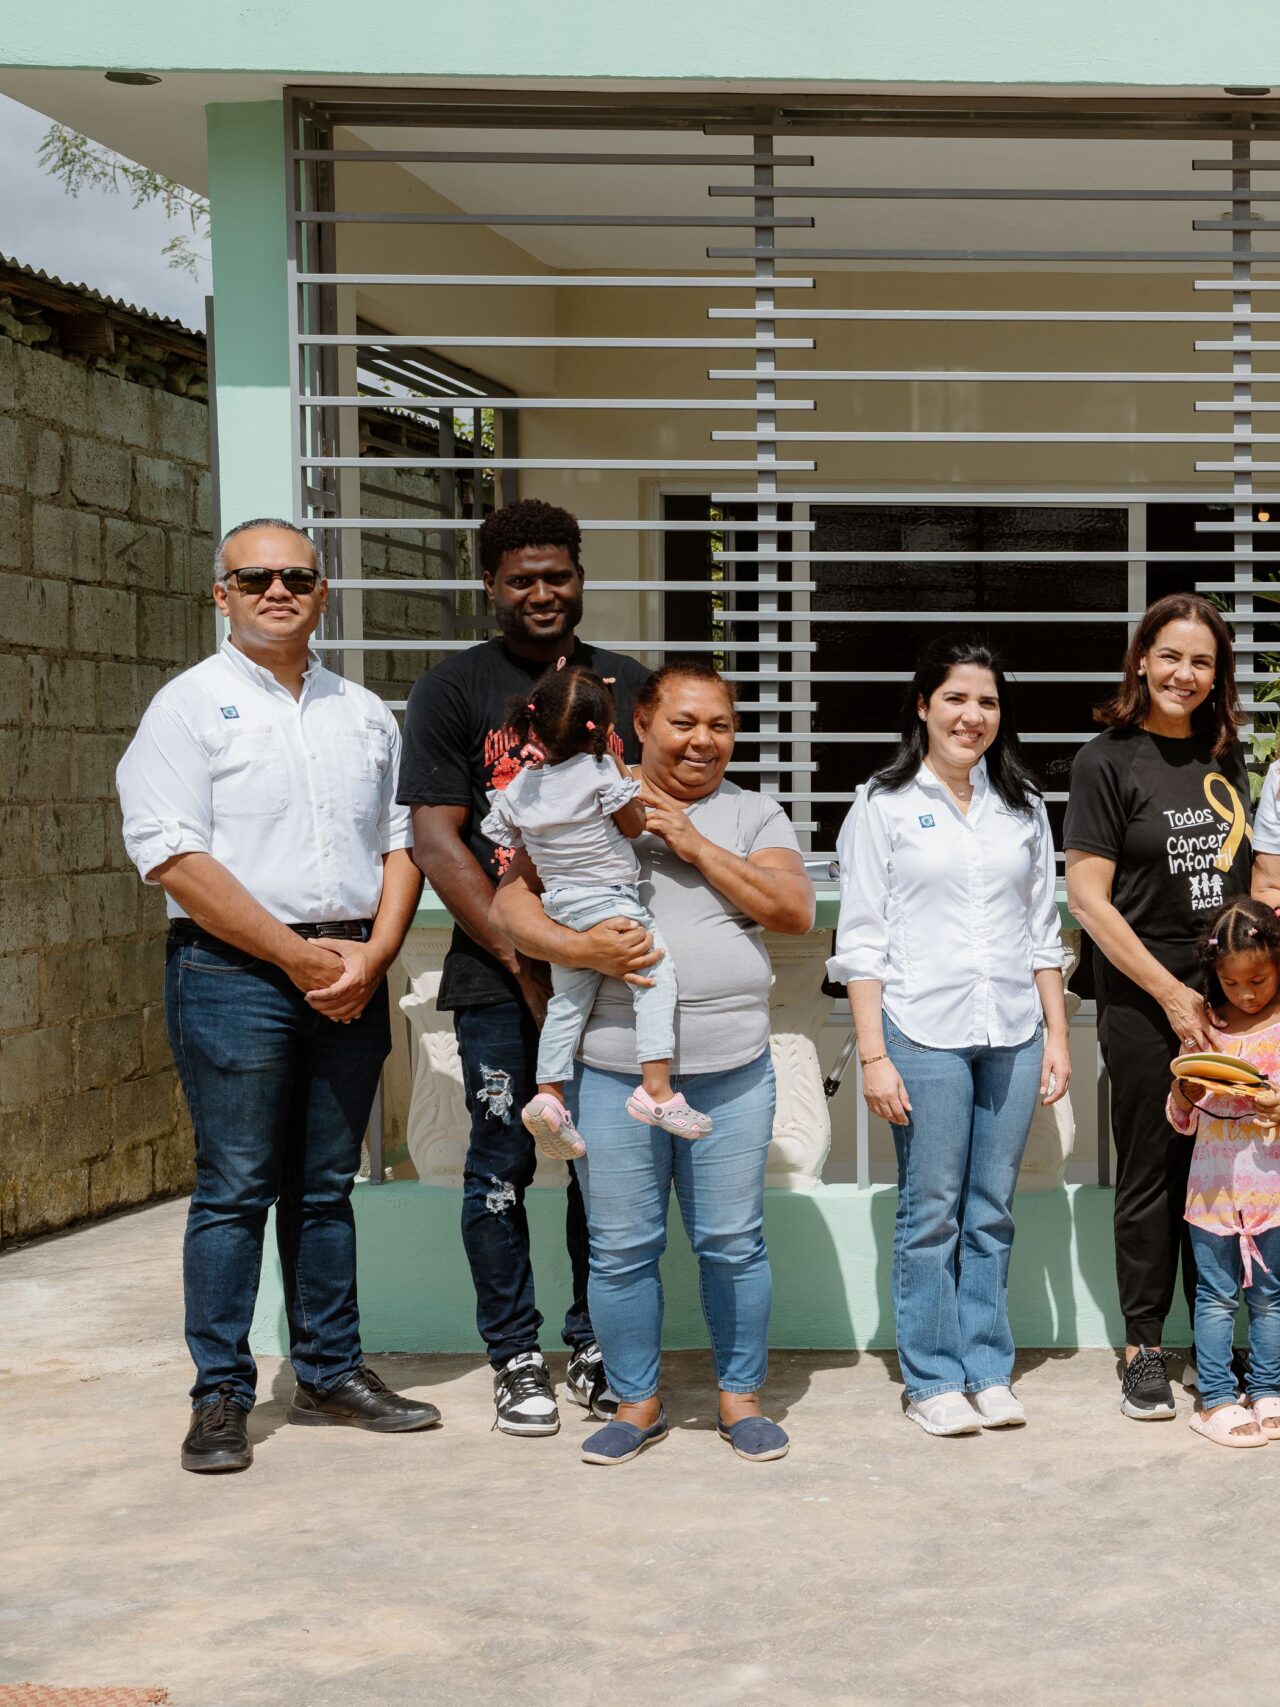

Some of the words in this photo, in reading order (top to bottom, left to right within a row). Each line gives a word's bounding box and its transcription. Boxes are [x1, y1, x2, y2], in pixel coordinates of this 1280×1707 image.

[1163, 807, 1214, 828] Todos
[1216, 822, 1230, 832] vs
[1166, 832, 1227, 855] Cáncer
[1168, 847, 1234, 875] Infantil
[1191, 896, 1224, 911] FACCI
